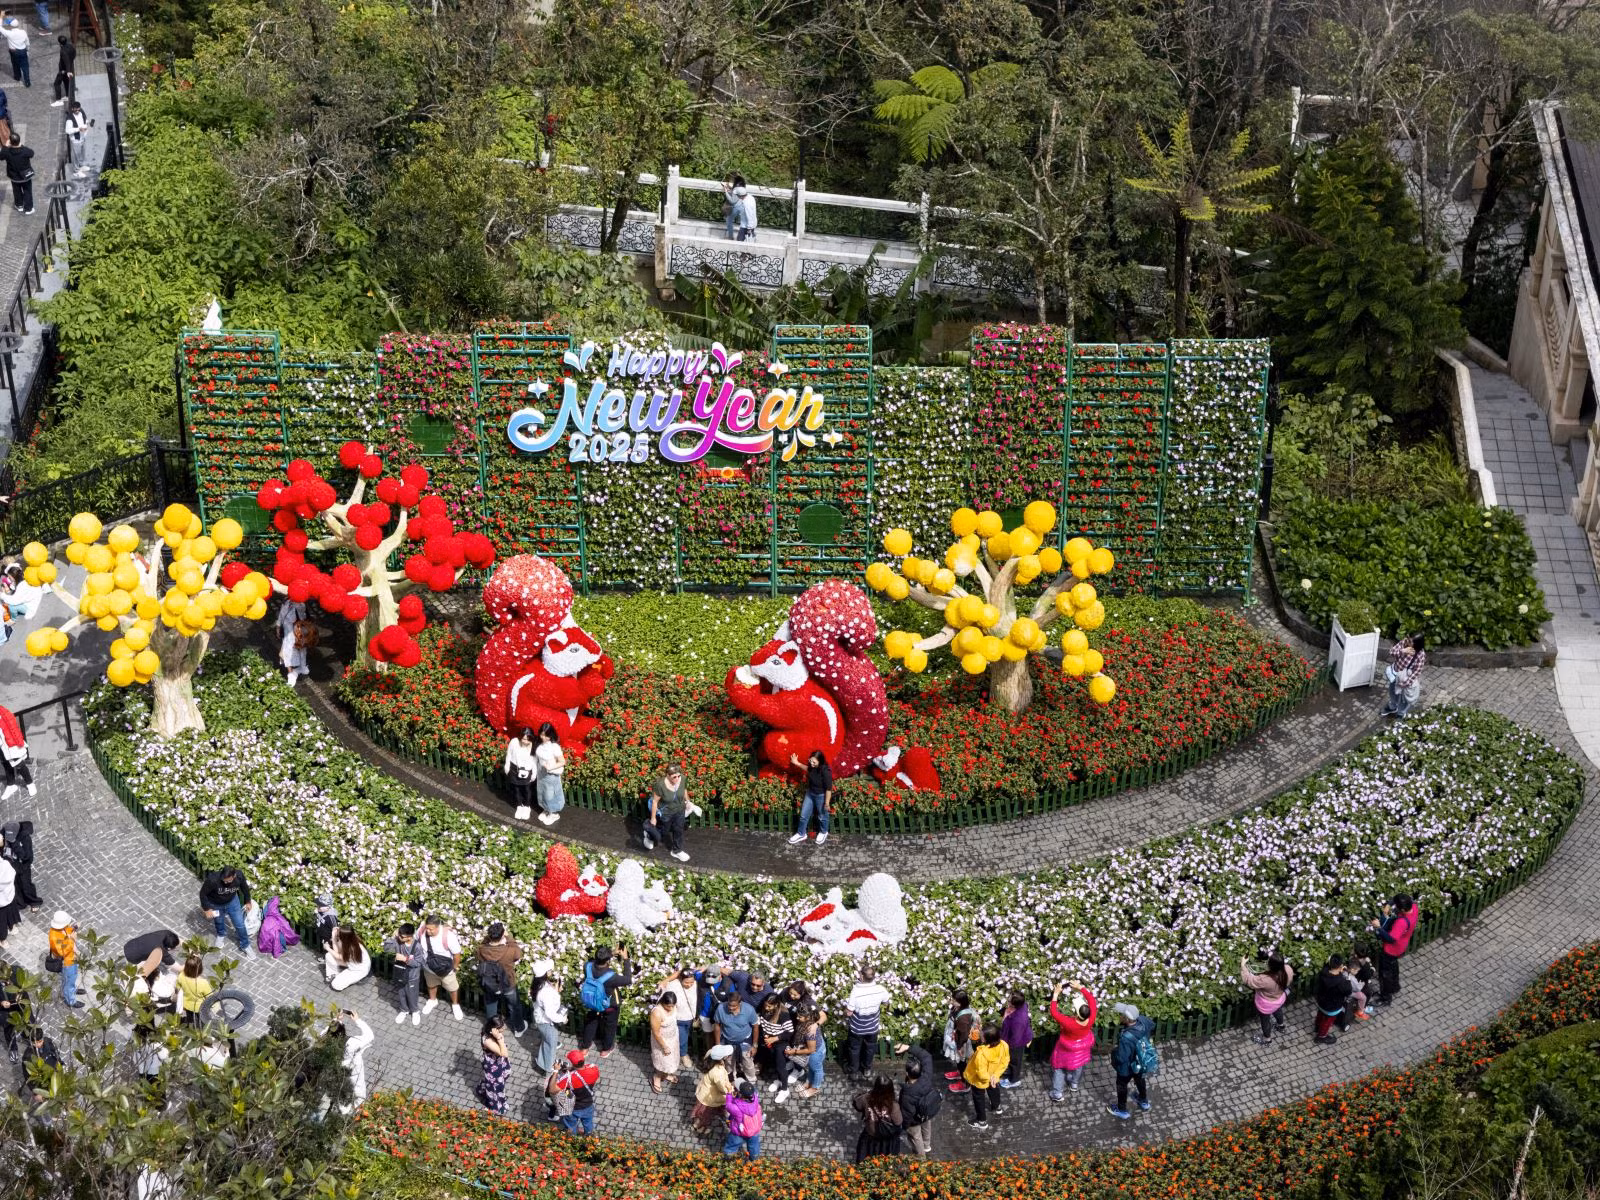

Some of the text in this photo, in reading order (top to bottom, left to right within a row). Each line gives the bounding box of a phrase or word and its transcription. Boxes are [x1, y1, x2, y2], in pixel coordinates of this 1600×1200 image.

[607, 343, 708, 384] Happy
[507, 375, 825, 463] New Year
[568, 432, 650, 463] 2025
